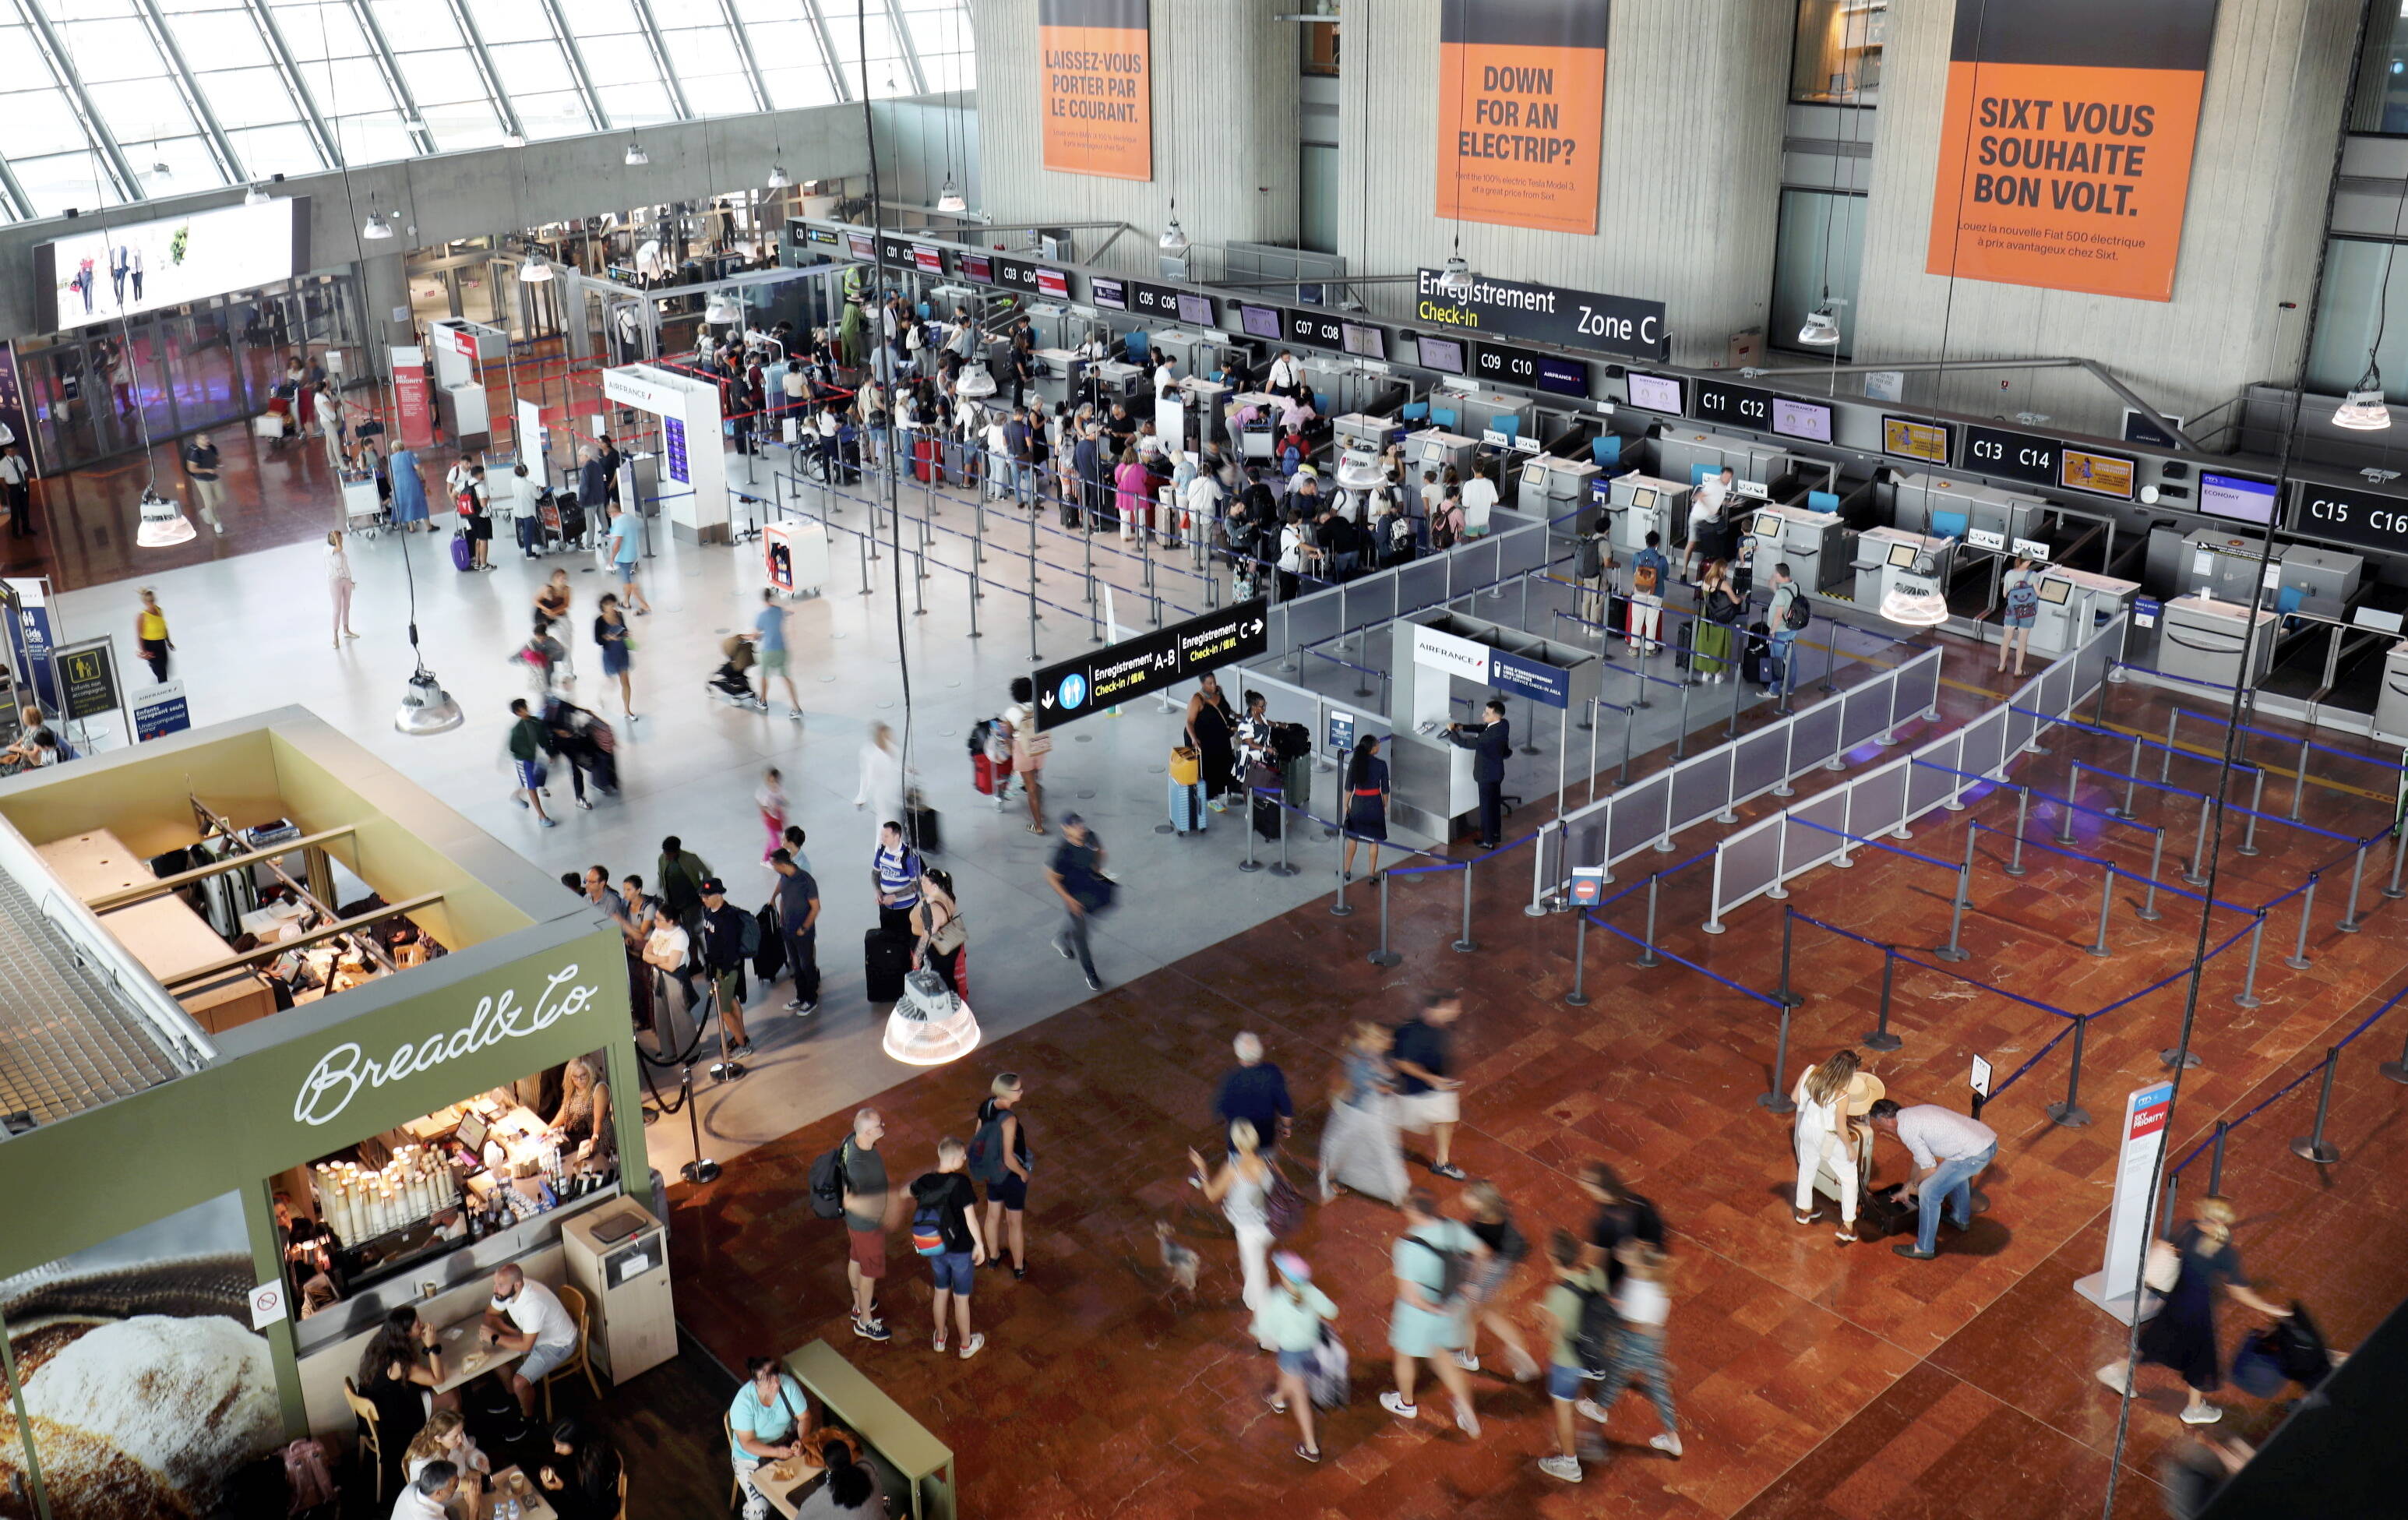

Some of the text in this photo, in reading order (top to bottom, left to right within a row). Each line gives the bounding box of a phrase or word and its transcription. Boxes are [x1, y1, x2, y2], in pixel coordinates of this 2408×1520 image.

[1045, 49, 1141, 73] LAISSEZ-VOUS
[1052, 74, 1136, 98] PORTER PAR
[1483, 65, 1553, 95] DOWN
[1052, 97, 1138, 123] LE COURANT.
[1476, 99, 1559, 130] FOR AN
[1979, 97, 2156, 137] SIXT VOUS
[1459, 131, 1576, 166] ELECTRIP?
[1979, 135, 2146, 178] SOUHAITE
[1455, 171, 1470, 181] Rent
[1472, 172, 1482, 182] the
[1483, 174, 1502, 184] 100%
[1503, 175, 1527, 186] electric
[1528, 178, 1545, 188] Tesla
[1546, 179, 1567, 190] Model
[1485, 186, 1503, 196] great
[1504, 189, 1521, 199] price
[1523, 190, 1539, 199] from
[1974, 172, 2138, 217] BON VOLT.
[796, 227, 804, 239] C0
[1958, 222, 2145, 249] Louez la nouvelle Fiat 500 électrique
[887, 245, 897, 259] C01
[904, 249, 914, 262] C02
[1977, 236, 2119, 261] à prix avantageux chez Sixt.
[1003, 266, 1036, 284] C03 C04
[1139, 291, 1154, 306] C05
[1161, 295, 1176, 310] C06
[1419, 301, 1478, 327] Check-In
[1577, 305, 1632, 341] Zone
[1640, 316, 1656, 344] C
[1296, 319, 1313, 335] C07
[1321, 324, 1339, 340] C08
[1481, 353, 1532, 376] C09 C10
[1543, 371, 1572, 381] AIRFRANCE
[608, 381, 646, 400] AIRFRANCE
[1703, 392, 1765, 418] C11 C12
[1973, 440, 2049, 469] C13 C14
[2205, 489, 2239, 500] ECONOMY
[2311, 499, 2408, 534] C15 C16
[1183, 622, 1248, 650] Enregistrement C
[1190, 645, 1218, 662] Check-in
[1419, 642, 1474, 665] AIRFRANCE
[1095, 649, 1176, 682] Enregistrement A-B
[71, 684, 90, 693] Enfants
[72, 686, 107, 698] accompagnés
[139, 689, 171, 700] AIRFRANCE
[1095, 678, 1125, 697] Check-in
[136, 706, 160, 717] Enfants
[137, 703, 185, 721] voyageant seuls
[138, 711, 185, 730] Unaccompanied
[139, 726, 157, 735] minor
[2133, 1112, 2164, 1130] PRIORITY
[2135, 1112, 2148, 1122] SKY
